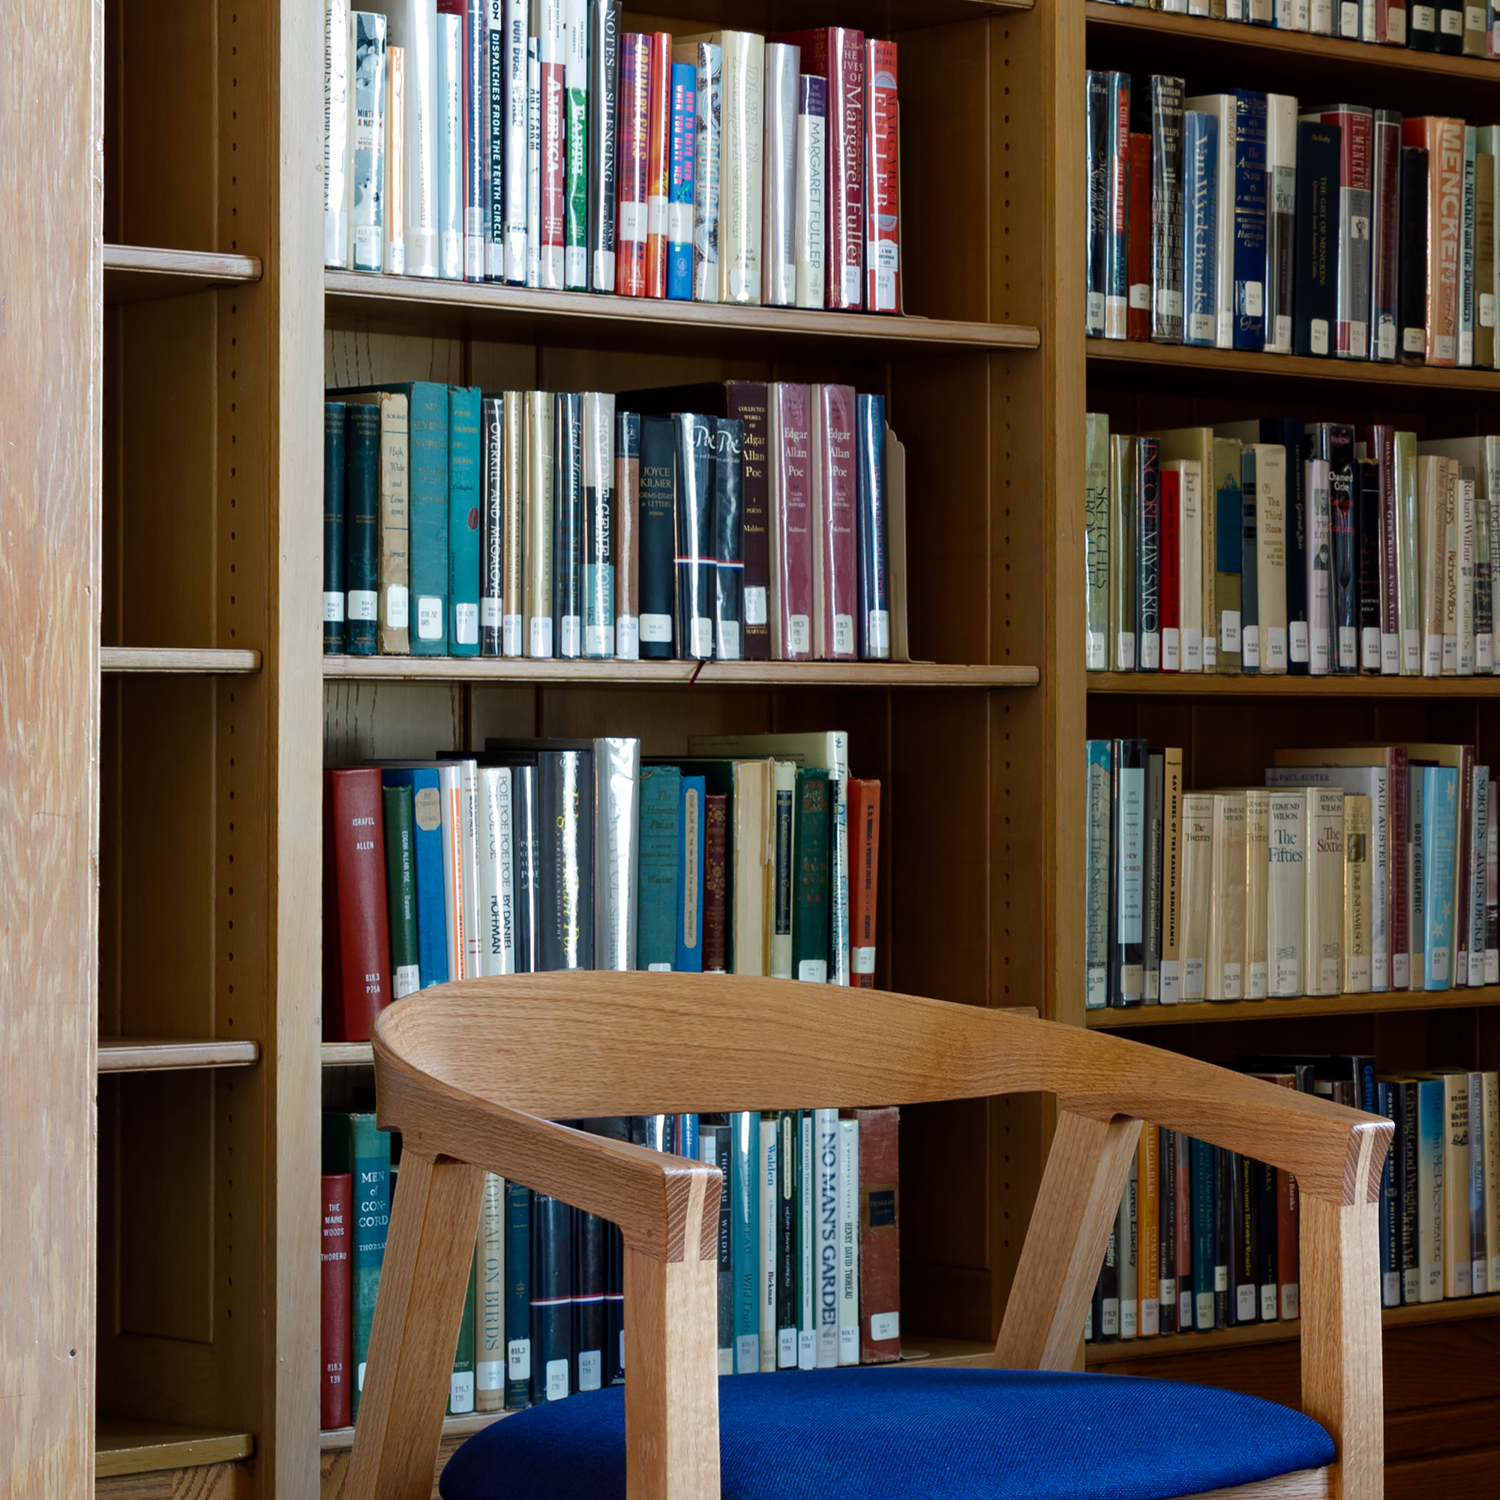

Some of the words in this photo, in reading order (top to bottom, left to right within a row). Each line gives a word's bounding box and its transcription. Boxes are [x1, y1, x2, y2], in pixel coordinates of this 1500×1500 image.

[491, 33, 500, 92] DISPATCHES
[675, 85, 684, 110] WHEN
[685, 92, 694, 113] HOW
[492, 95, 500, 125] FROM
[675, 115, 683, 133] YOU
[685, 117, 694, 129] TO
[492, 133, 500, 153] THE
[674, 137, 683, 161] HATE
[684, 133, 693, 157] DATE
[684, 161, 693, 180] MEN
[811, 121, 820, 205] MARGARET
[493, 156, 501, 197] TENTH
[673, 165, 682, 185] MEN
[493, 200, 502, 244] CIRCLE
[810, 209, 820, 269] FULLER
[784, 428, 808, 442] Edgar
[490, 422, 503, 482] OVERKILL
[785, 449, 807, 458] Allan
[642, 467, 670, 478] JOYCE
[788, 466, 804, 476] Poe
[640, 478, 672, 488] KILMER
[490, 488, 502, 519] AND
[490, 525, 503, 597] MEGALOVE
[1272, 803, 1300, 811] EDMUND
[352, 818, 375, 826] ISRAFEL
[1273, 812, 1298, 820] WILSON
[1275, 829, 1297, 845] The
[356, 841, 374, 850] ALLEN
[1268, 848, 1303, 863] Fifties
[365, 974, 380, 982] 818.3
[366, 985, 381, 993] P75A
[822, 1133, 836, 1167] NO
[361, 1172, 384, 1183] MEN
[370, 1186, 378, 1196] of
[328, 1204, 340, 1212] THE
[361, 1200, 385, 1212] CON-
[822, 1173, 836, 1240] MAN'S
[325, 1215, 343, 1224] MAINE
[358, 1215, 388, 1228] CORD
[323, 1228, 344, 1236] WOODS
[320, 1252, 346, 1261] THOREAU
[484, 1258, 499, 1283] ON
[484, 1287, 500, 1350] BIRDS
[327, 1363, 342, 1372] 818.3
[330, 1375, 340, 1384] T39
